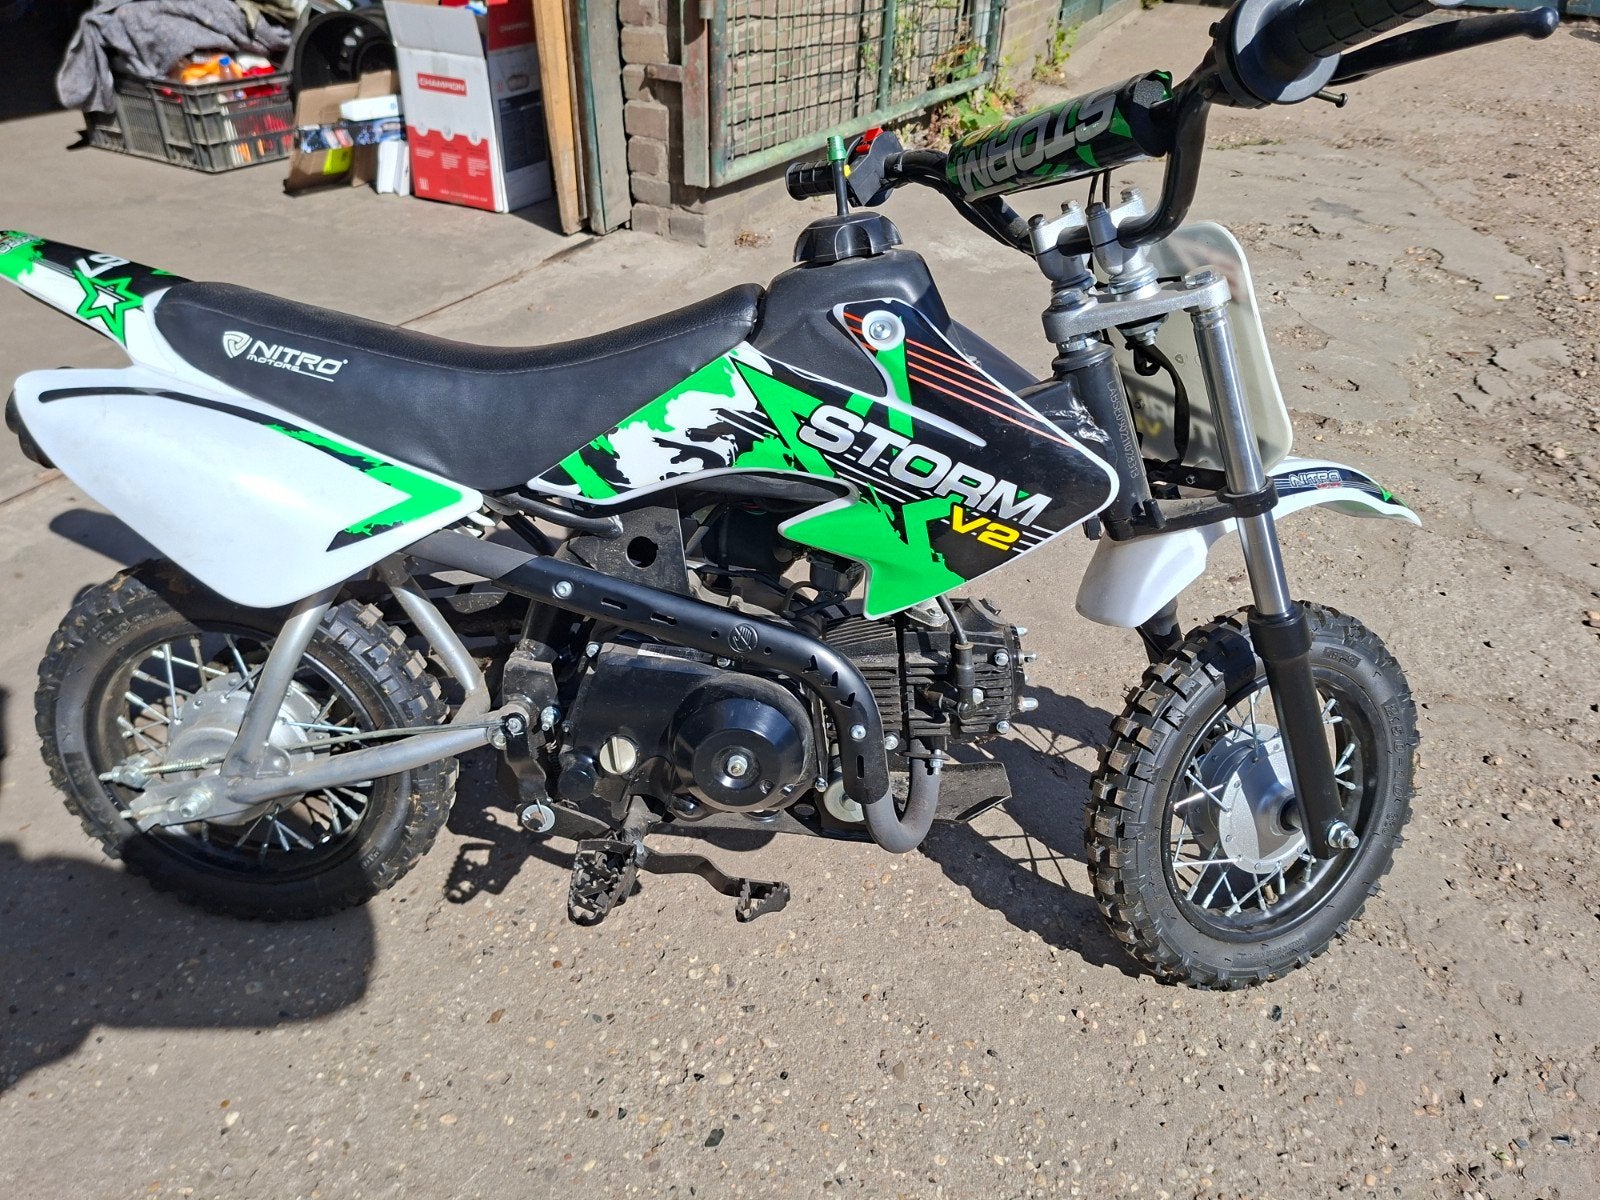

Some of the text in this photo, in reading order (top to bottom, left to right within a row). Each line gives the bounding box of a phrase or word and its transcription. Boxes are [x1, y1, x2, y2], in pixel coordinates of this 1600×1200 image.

[957, 92, 1117, 196] STORM
[246, 354, 301, 372] MOTORS
[249, 340, 342, 375] NITRO
[799, 405, 1052, 527] STORM
[1289, 470, 1341, 488] NITRO
[953, 504, 1021, 551] V2
